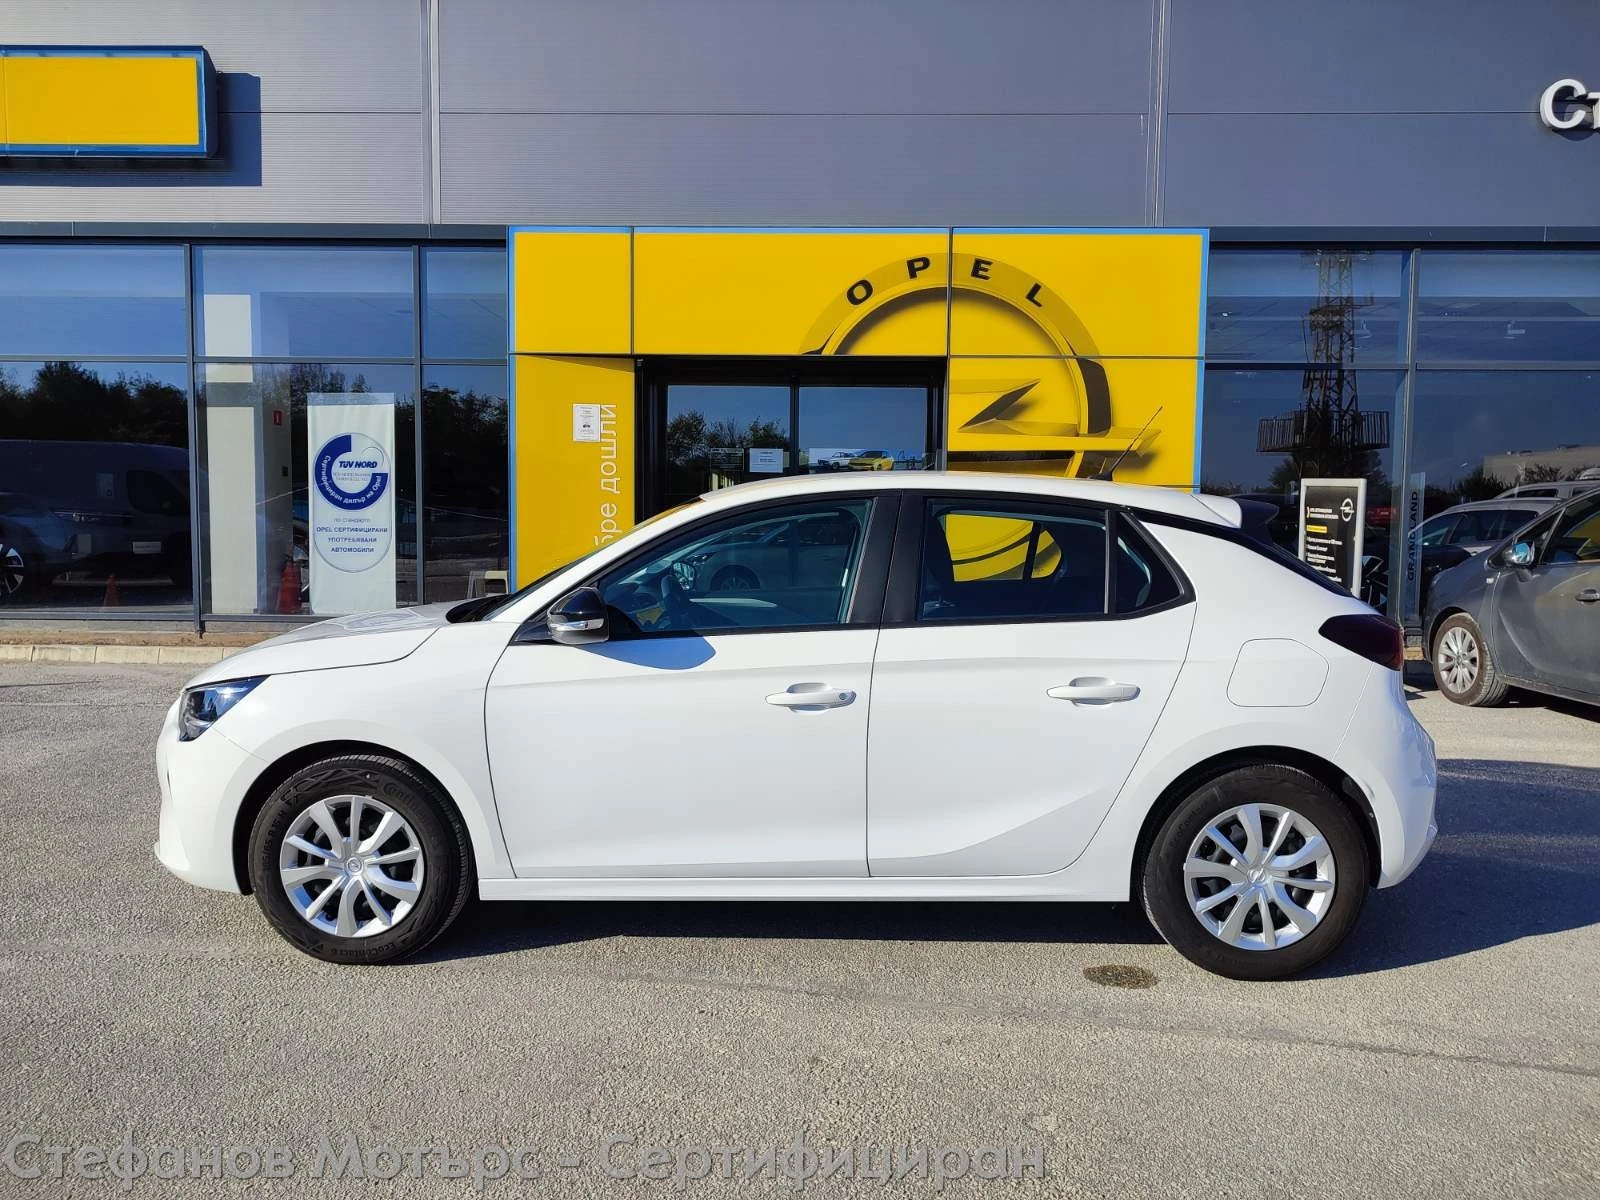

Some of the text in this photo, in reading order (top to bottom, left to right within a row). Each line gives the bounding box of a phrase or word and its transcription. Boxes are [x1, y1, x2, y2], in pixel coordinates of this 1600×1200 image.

[846, 256, 1043, 307] OPEL
[354, 461, 378, 469] NORD
[601, 404, 621, 494] дошли
[372, 475, 382, 491] Opel
[1407, 491, 1418, 581] GRANDLAND
